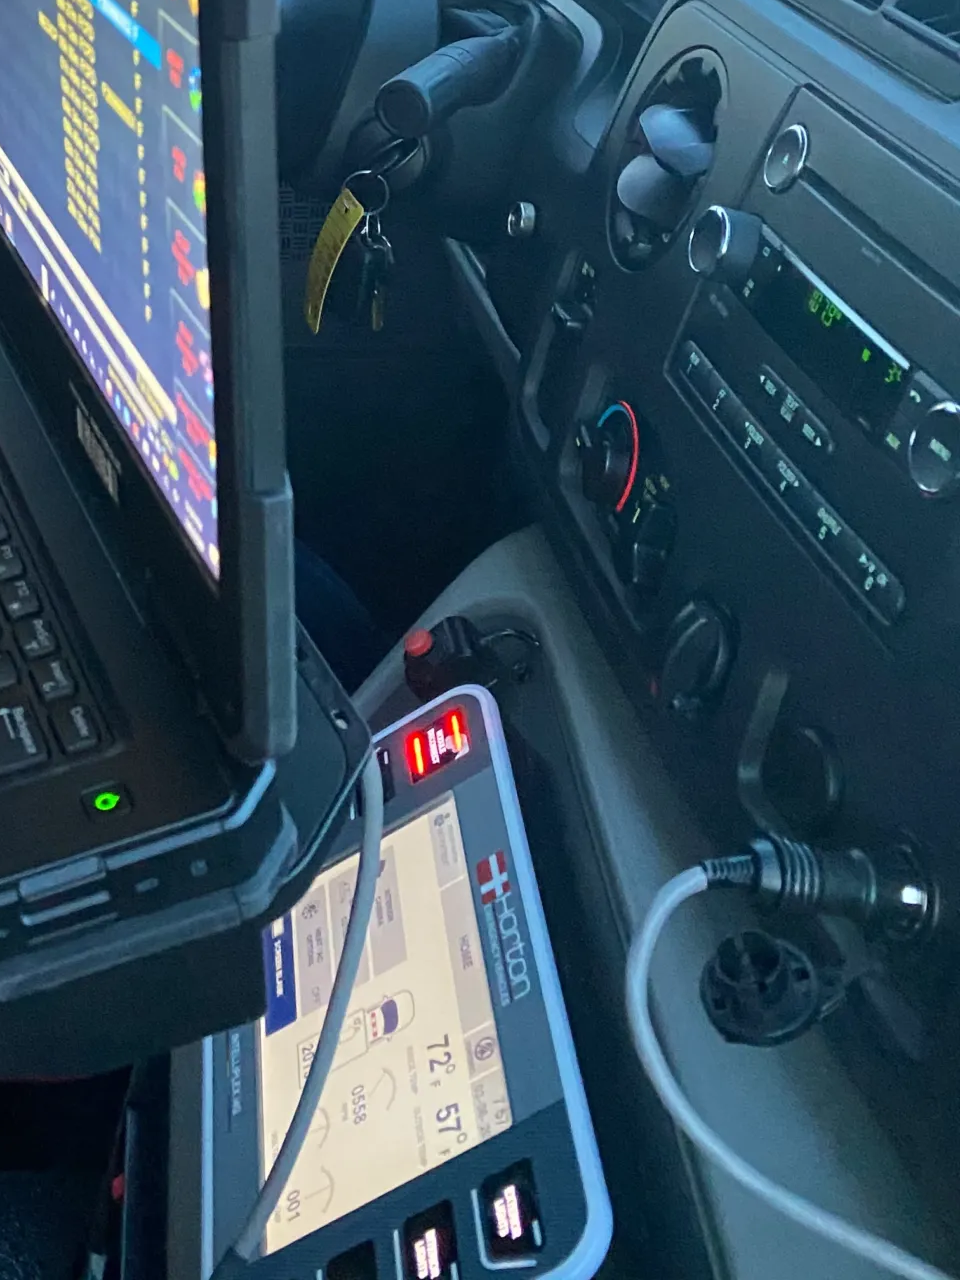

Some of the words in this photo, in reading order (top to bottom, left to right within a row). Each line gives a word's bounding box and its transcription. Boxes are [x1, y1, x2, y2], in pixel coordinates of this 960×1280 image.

[458, 935, 474, 970] HOME
[494, 891, 531, 1000] Horton
[351, 1085, 366, 1124] 0558
[286, 1190, 301, 1222] 001
